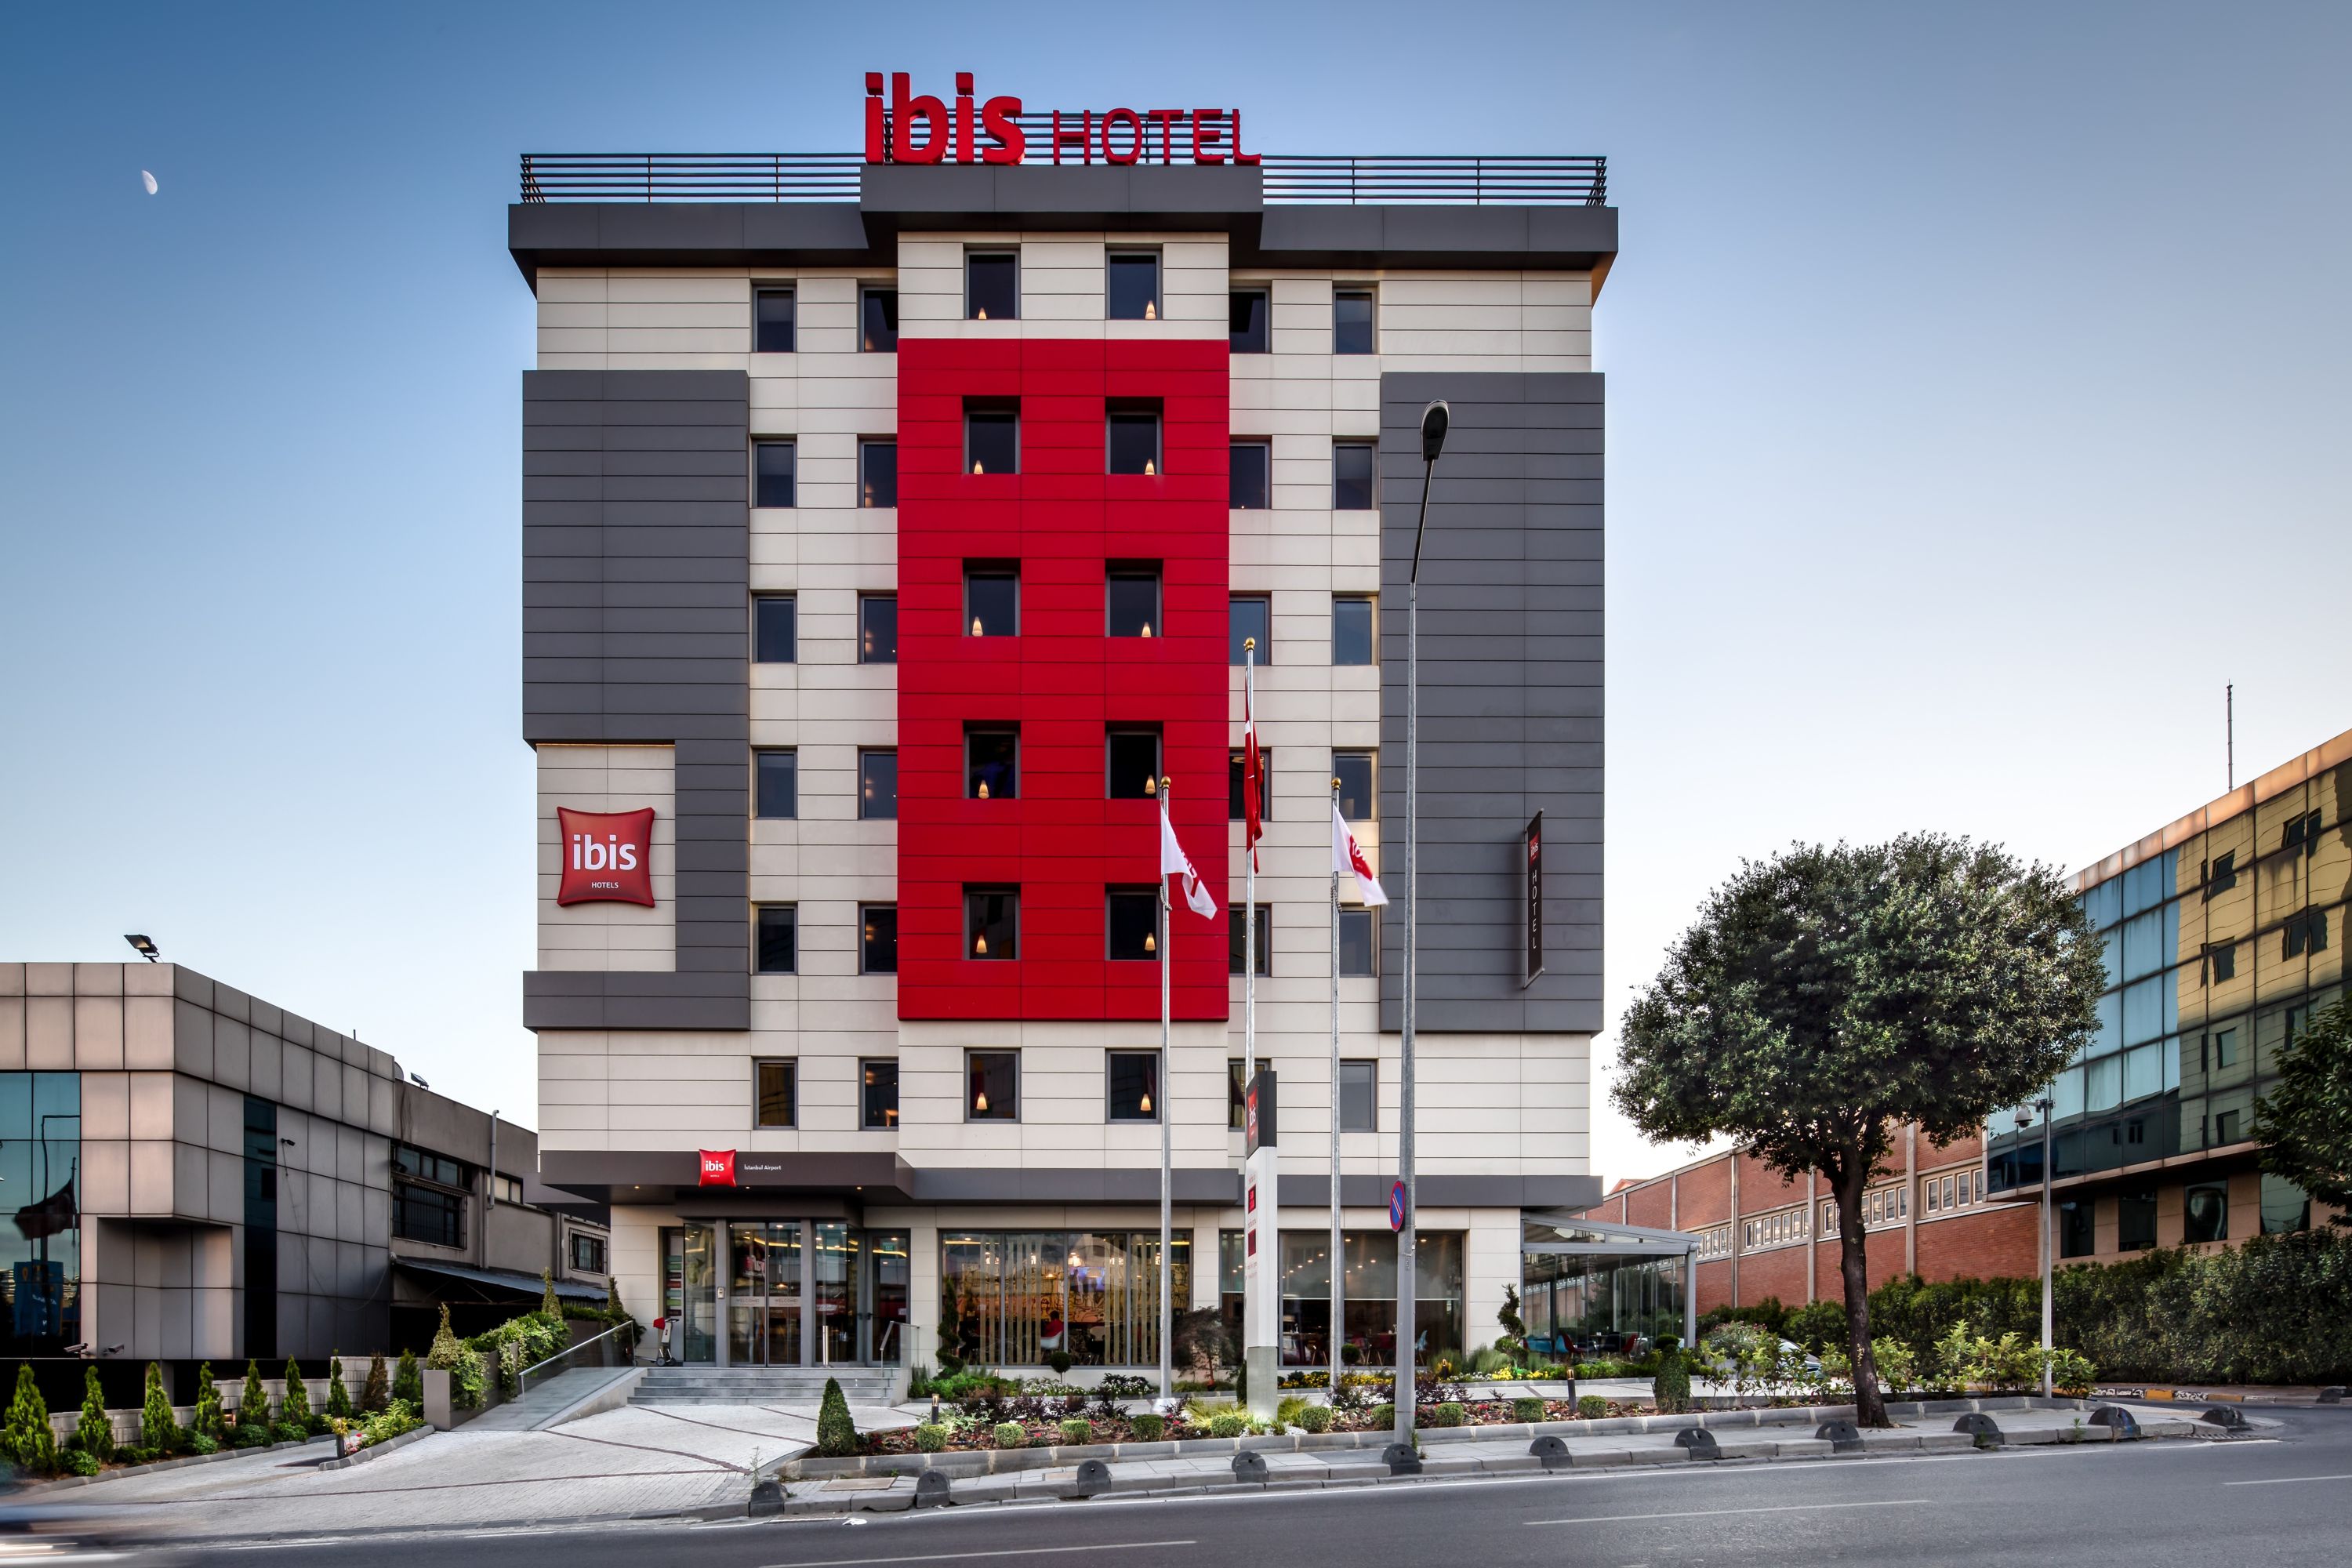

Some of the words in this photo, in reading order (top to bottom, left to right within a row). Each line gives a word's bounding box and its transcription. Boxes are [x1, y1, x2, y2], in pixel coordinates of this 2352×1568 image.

[865, 71, 1025, 165] ibis
[1053, 107, 1261, 166] HOTEL
[573, 833, 637, 871] ibis
[705, 1160, 725, 1172] ibis
